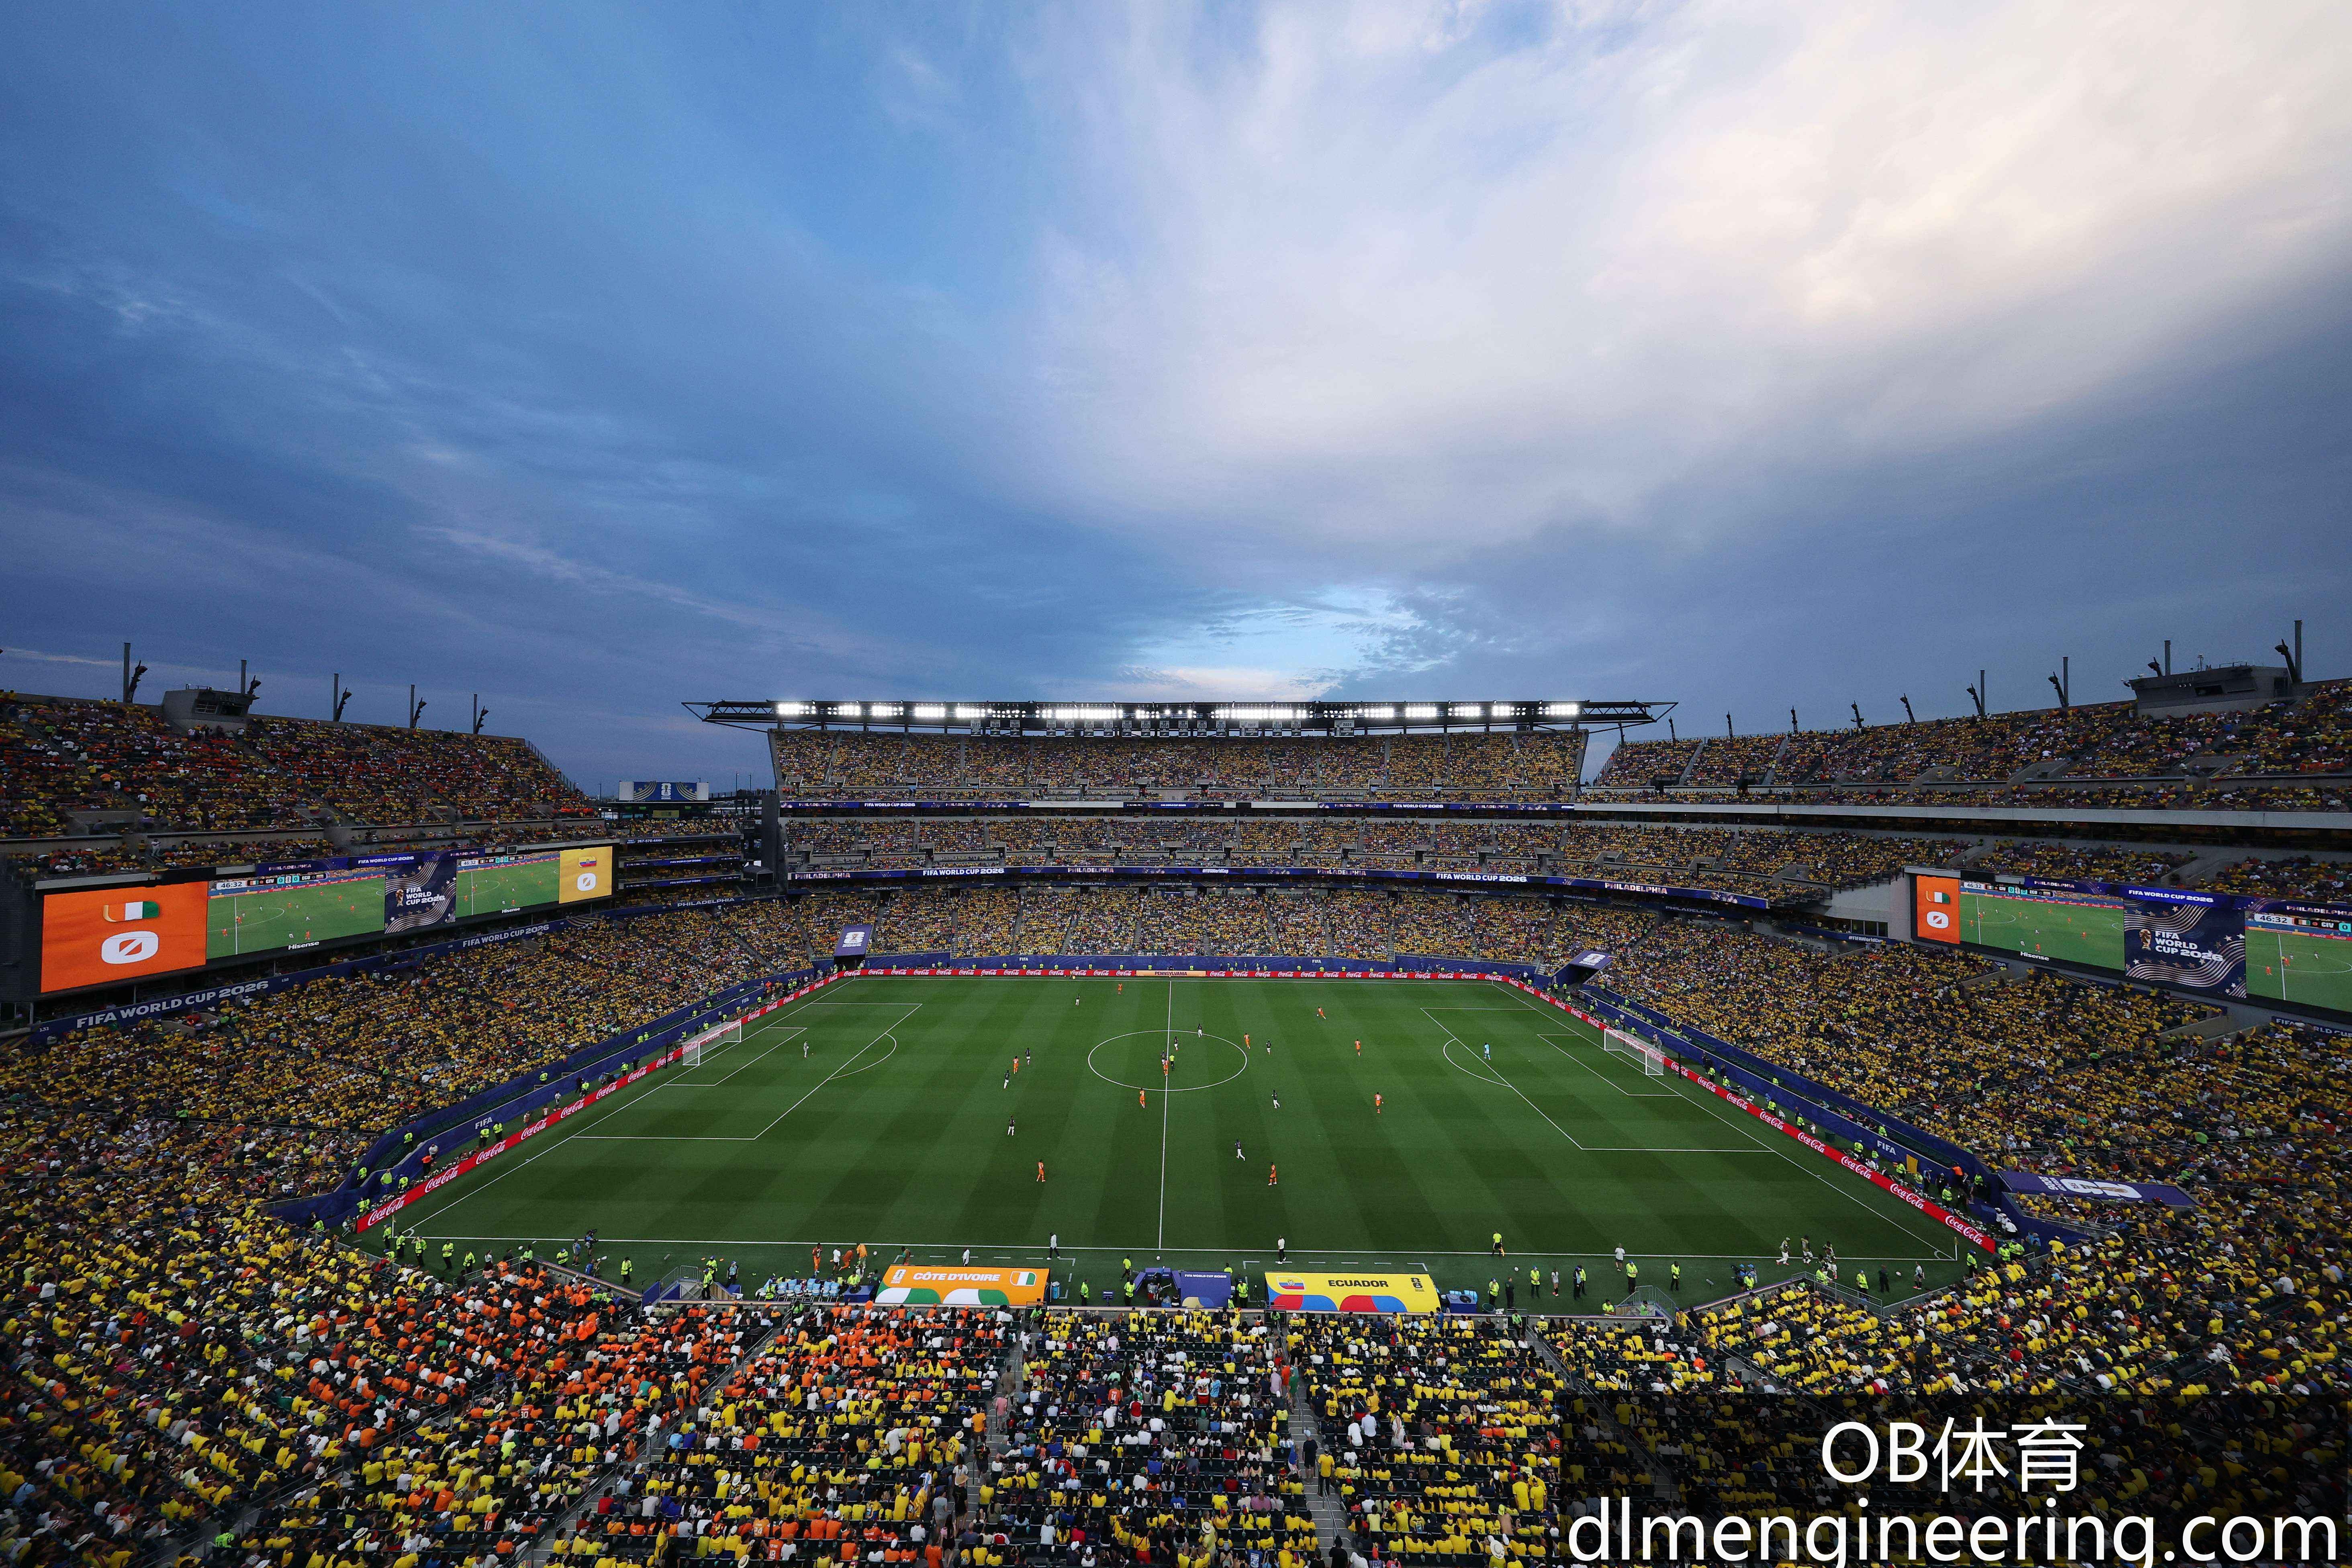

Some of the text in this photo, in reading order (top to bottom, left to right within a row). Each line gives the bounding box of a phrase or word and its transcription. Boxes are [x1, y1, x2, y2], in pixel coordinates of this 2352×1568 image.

[1605, 883, 1667, 894] PHILADELPHIA
[2034, 880, 2075, 888] PHILADELPHIA
[406, 891, 431, 900] WORLD
[421, 895, 445, 904] 2026
[677, 898, 735, 907] PHILADELPHIA
[1665, 906, 1719, 915] PHILADELPHIA
[2287, 905, 2352, 916] PHILADELPHIA
[2260, 915, 2287, 923] 46:32
[463, 939, 481, 947] FIFA
[481, 933, 509, 943] WORLD
[510, 929, 524, 938] CUP
[525, 924, 549, 935] 2026
[2155, 931, 2180, 940] FIFA
[288, 941, 319, 950] Hisense
[2155, 938, 2197, 950] WORLD
[2020, 951, 2050, 961] Hisense
[2155, 945, 2223, 962] CUP 2026
[77, 981, 269, 1028] FIFA WORLD CUP 2026
[475, 1116, 492, 1129] FIFA
[1877, 1140, 1896, 1156] FIFA
[913, 1272, 1001, 1282] CÔTE D'IVOIRE
[484, 1521, 492, 1531] 10
